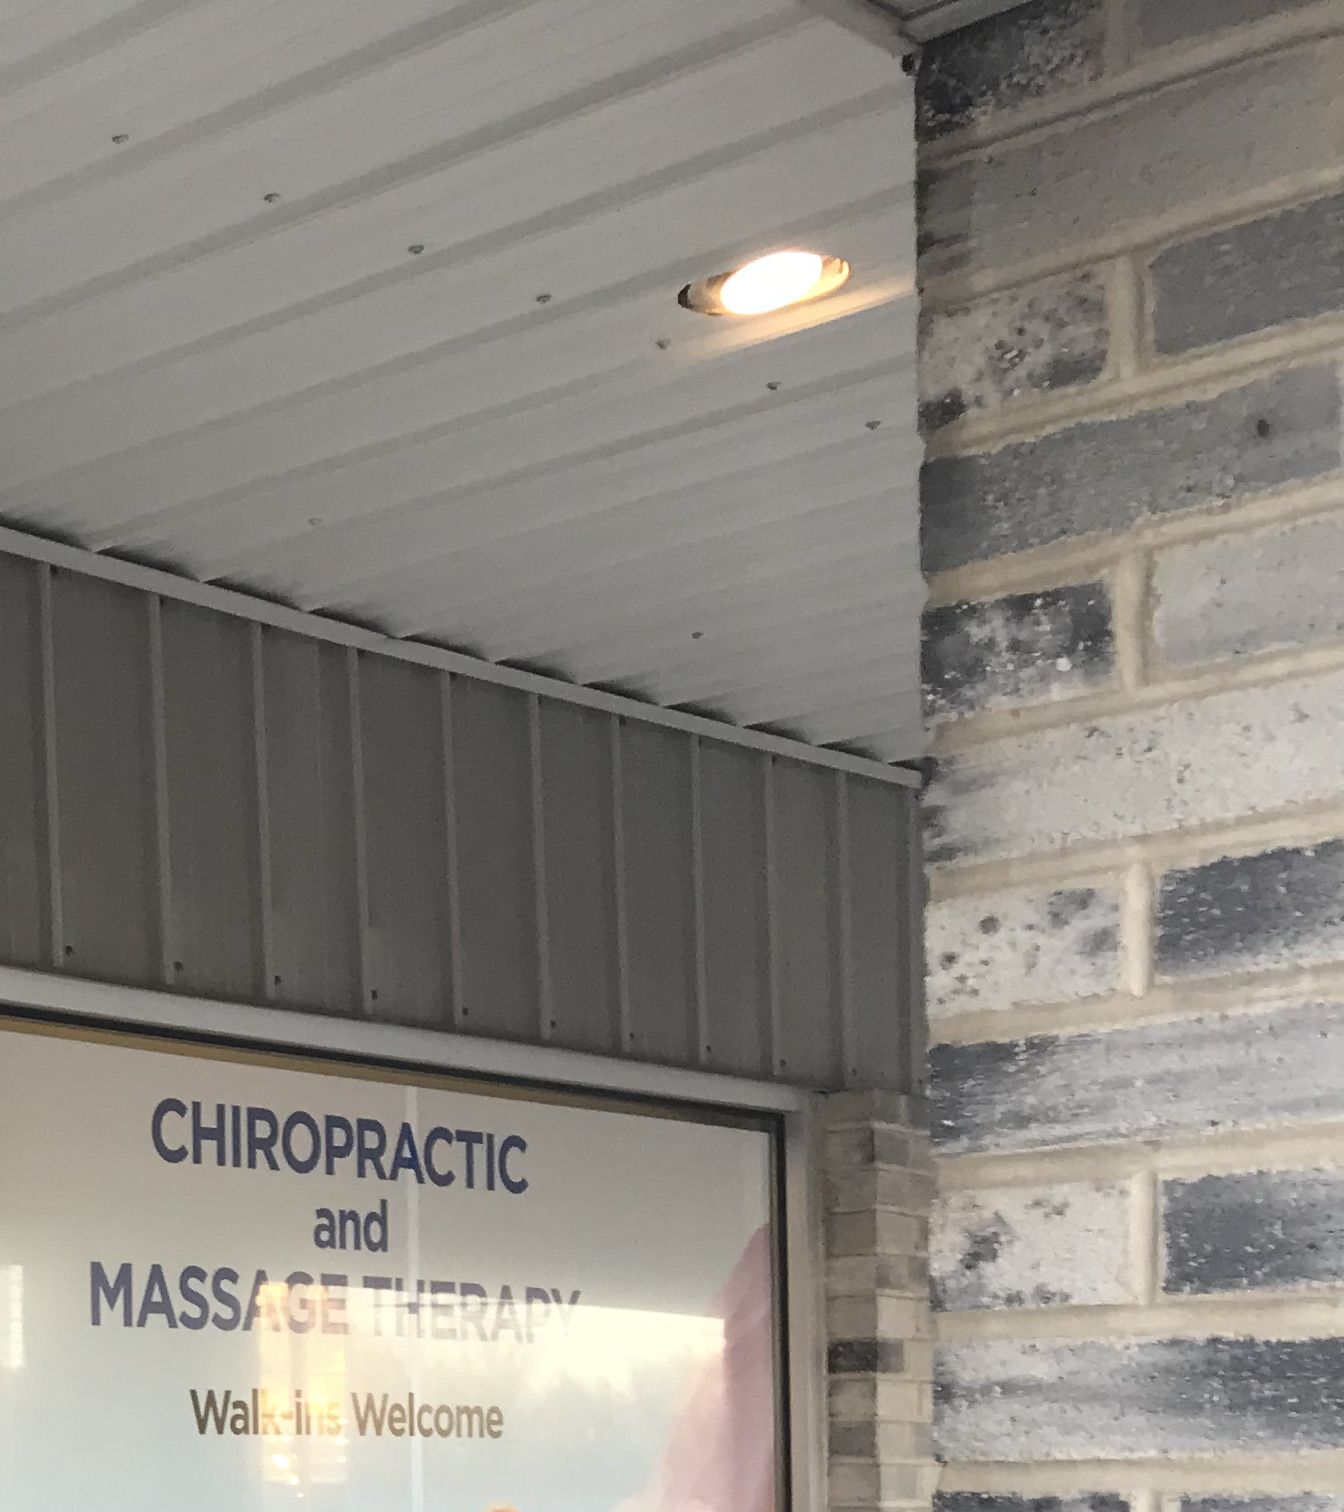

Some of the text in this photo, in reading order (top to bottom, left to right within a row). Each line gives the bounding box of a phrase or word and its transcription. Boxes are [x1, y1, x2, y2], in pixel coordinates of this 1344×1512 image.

[151, 1098, 529, 1194] CHIROPRACTIC
[313, 1200, 388, 1253] and
[90, 1262, 581, 1343] MASSAGE THERAPY
[190, 1389, 503, 1440] Walk-ins Welcome
